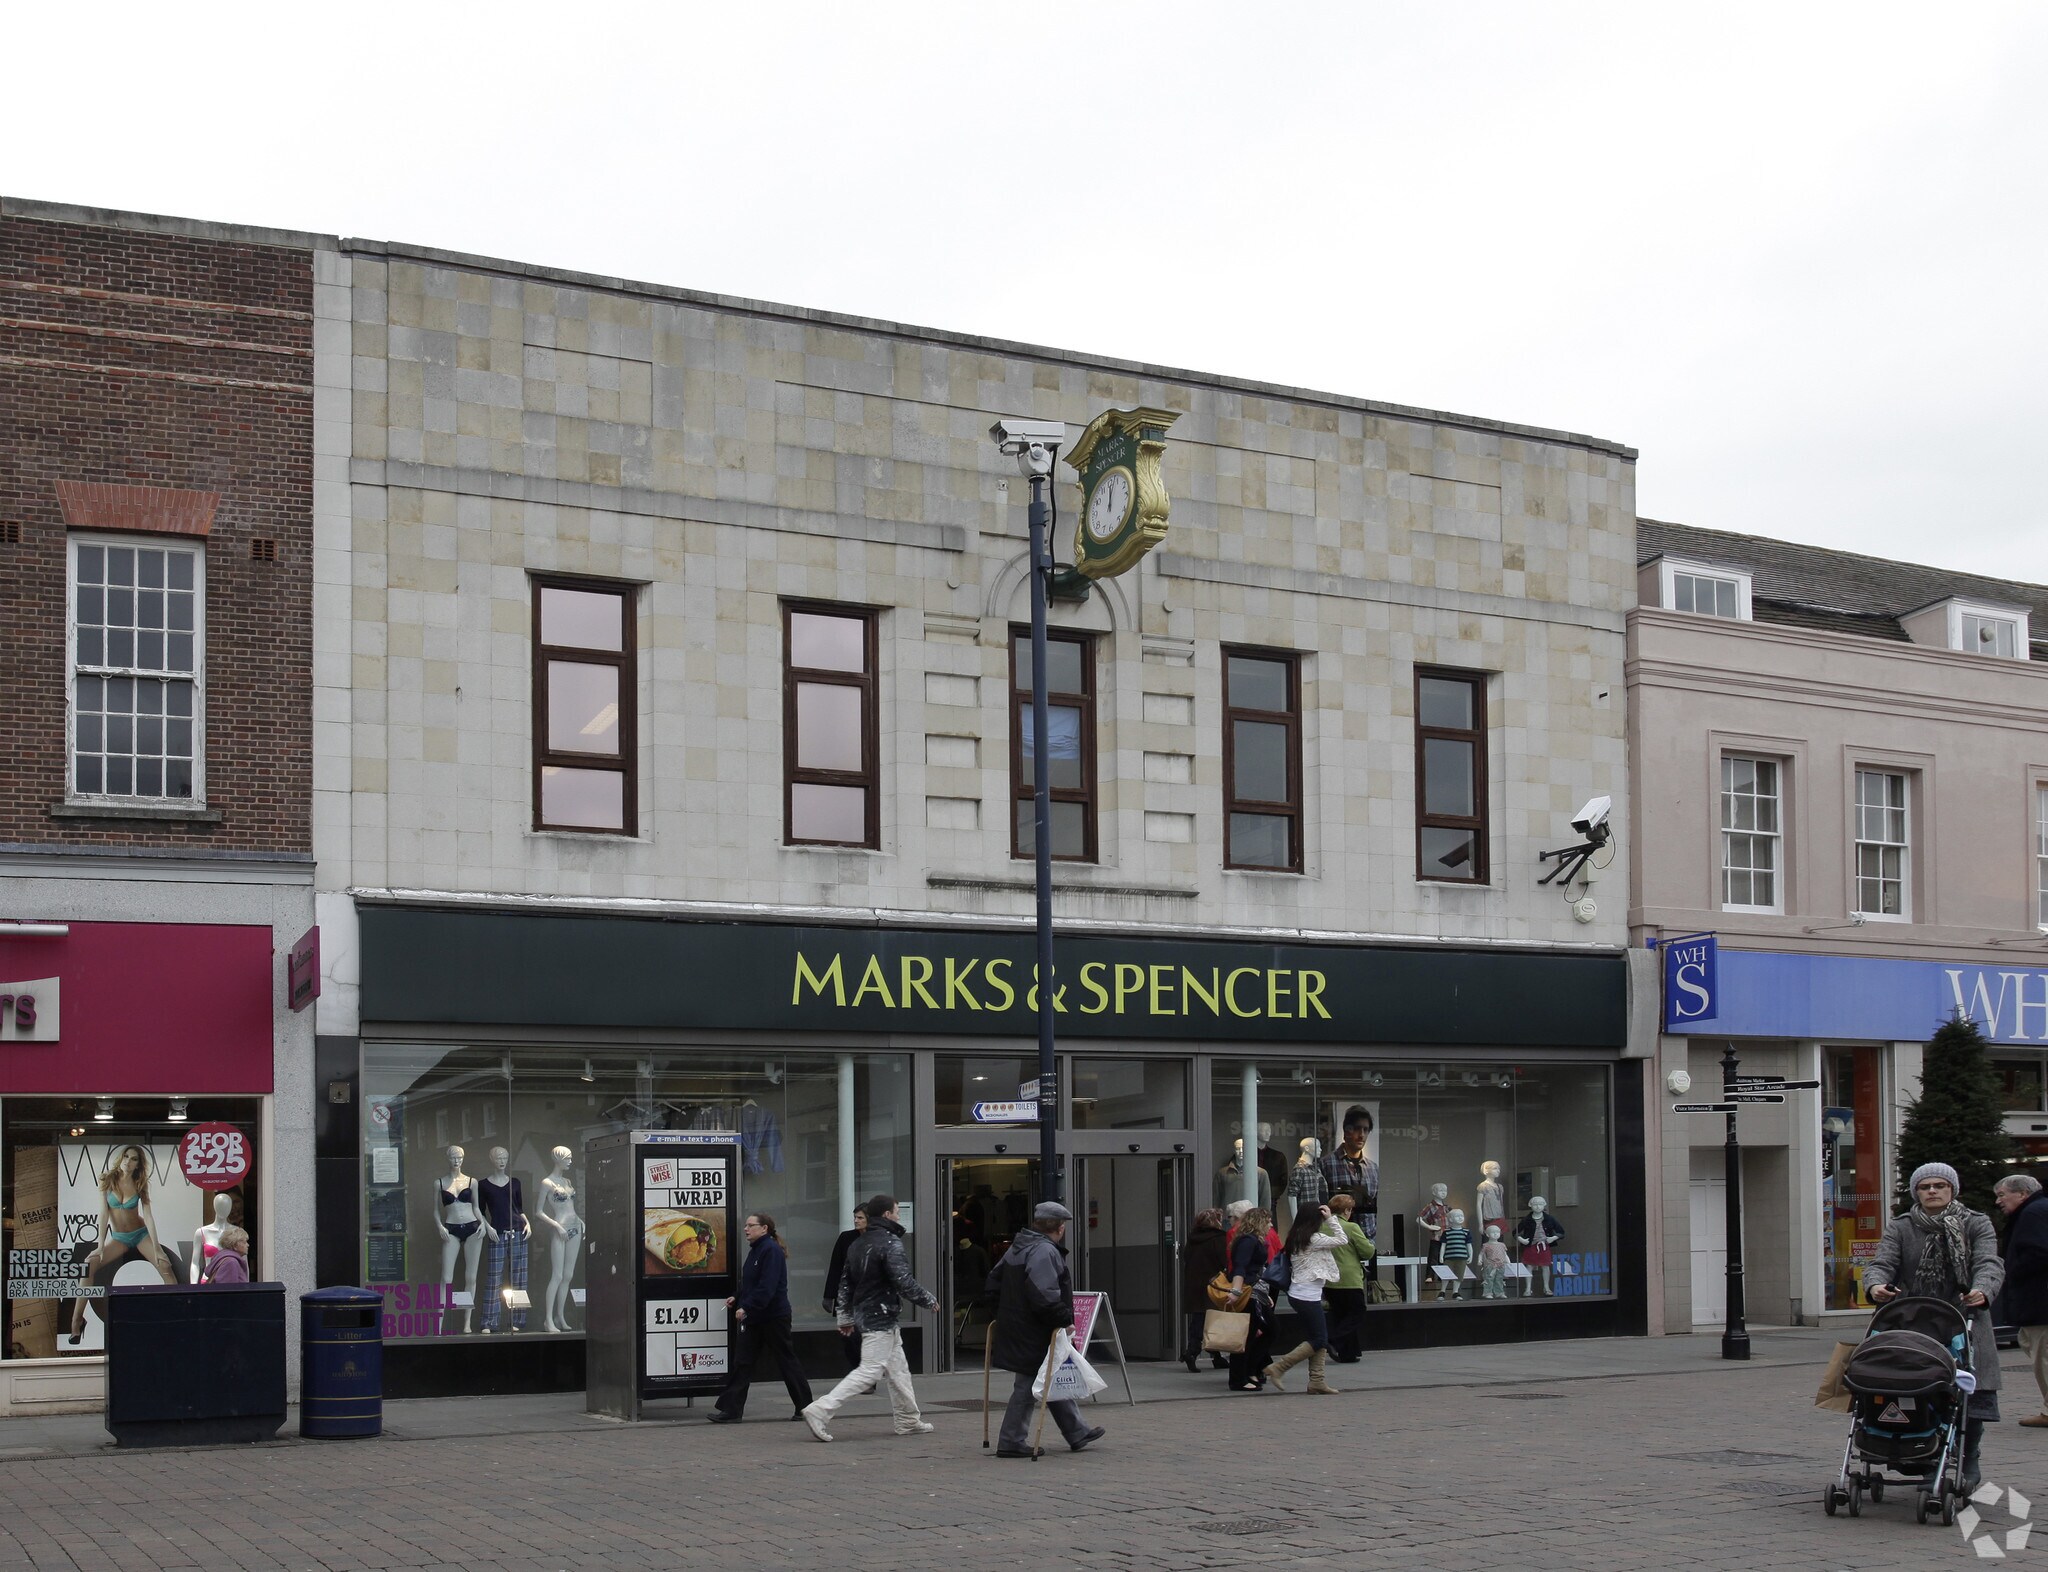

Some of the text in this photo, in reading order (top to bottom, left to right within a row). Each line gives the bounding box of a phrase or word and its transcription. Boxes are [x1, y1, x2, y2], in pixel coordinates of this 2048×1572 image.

[1675, 946, 1707, 964] WH
[792, 951, 1333, 1019] MARKS & SPENCER
[1675, 962, 1710, 1017] S
[1015, 1102, 1036, 1111] TOILETS
[185, 1148, 246, 1175] £25
[650, 1164, 669, 1174] STREET
[651, 1171, 672, 1183] WISE
[691, 1171, 722, 1186] BBQ
[674, 1190, 723, 1206] WRAP
[22, 1207, 53, 1220] REALISE
[24, 1213, 52, 1226] ASSETS
[9, 1249, 73, 1264] RISING
[1552, 1250, 1610, 1275] IT'S ALL
[9, 1263, 89, 1278] INTEREST
[9, 1280, 78, 1290] ASK US FOR A
[9, 1287, 105, 1298] BRA FITTING TODAY
[415, 1283, 457, 1310] ALL
[654, 1307, 700, 1325] £1.49
[337, 1332, 362, 1340] Litter
